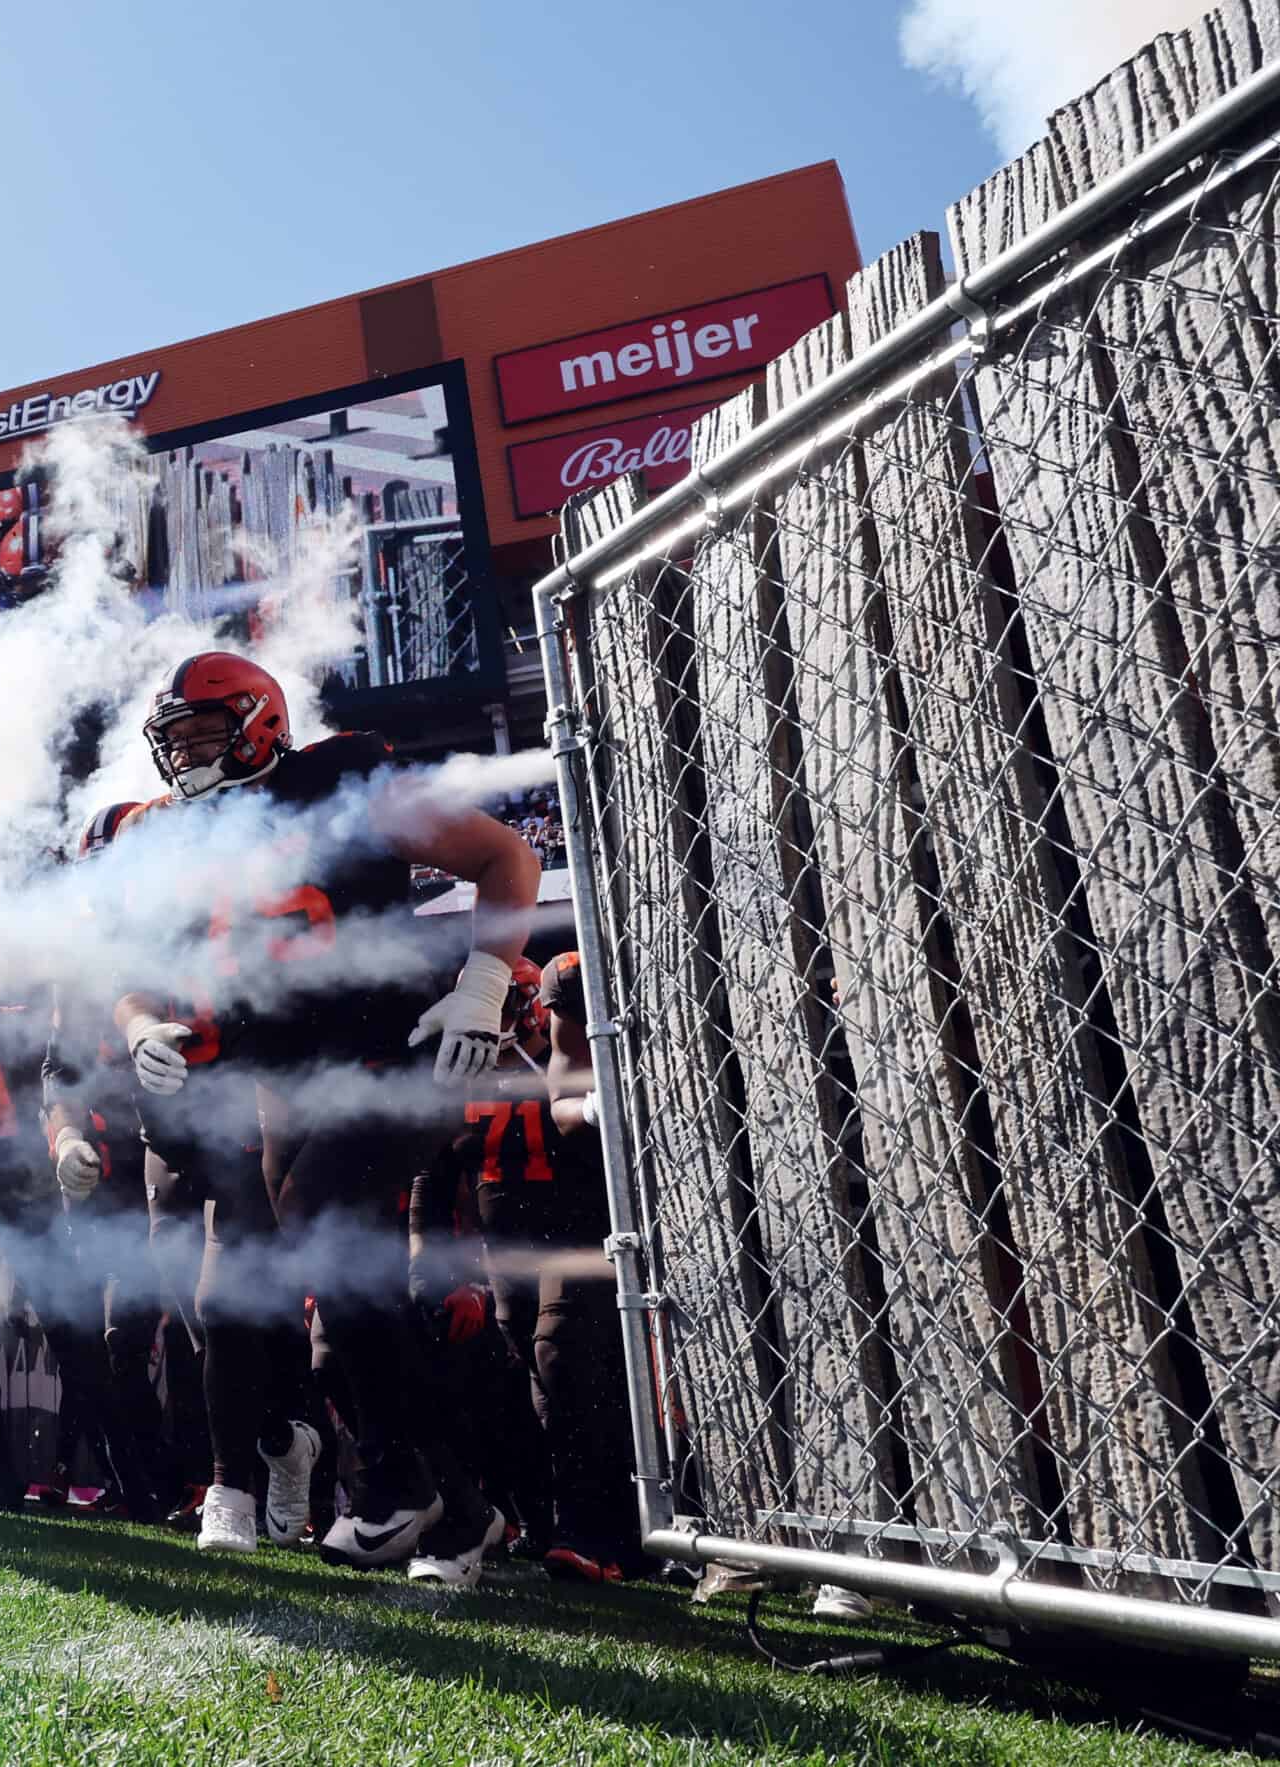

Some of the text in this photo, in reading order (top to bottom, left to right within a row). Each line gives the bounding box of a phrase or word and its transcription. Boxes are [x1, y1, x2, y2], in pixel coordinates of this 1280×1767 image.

[559, 313, 760, 393] meijer
[560, 427, 692, 487] Ball
[464, 1099, 554, 1182] 71
